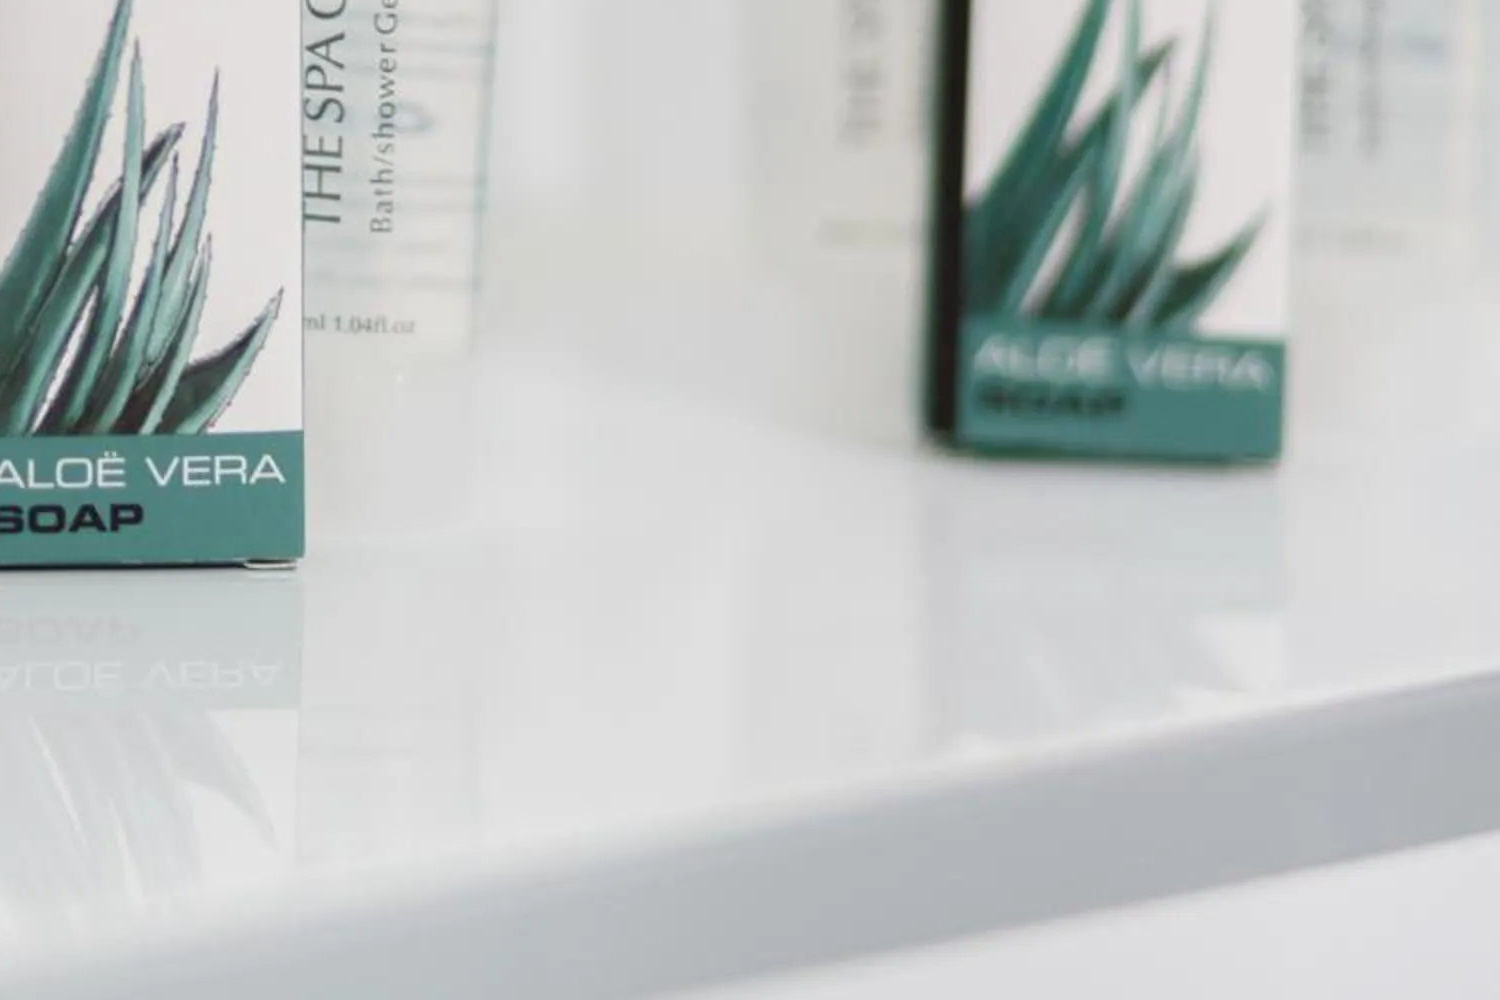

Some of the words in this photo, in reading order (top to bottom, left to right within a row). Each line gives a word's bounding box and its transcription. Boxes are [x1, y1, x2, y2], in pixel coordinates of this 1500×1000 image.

[303, 30, 347, 123] SPA
[302, 133, 345, 231] THE
[370, 40, 400, 233] Bath/shower
[145, 454, 287, 487] VERA
